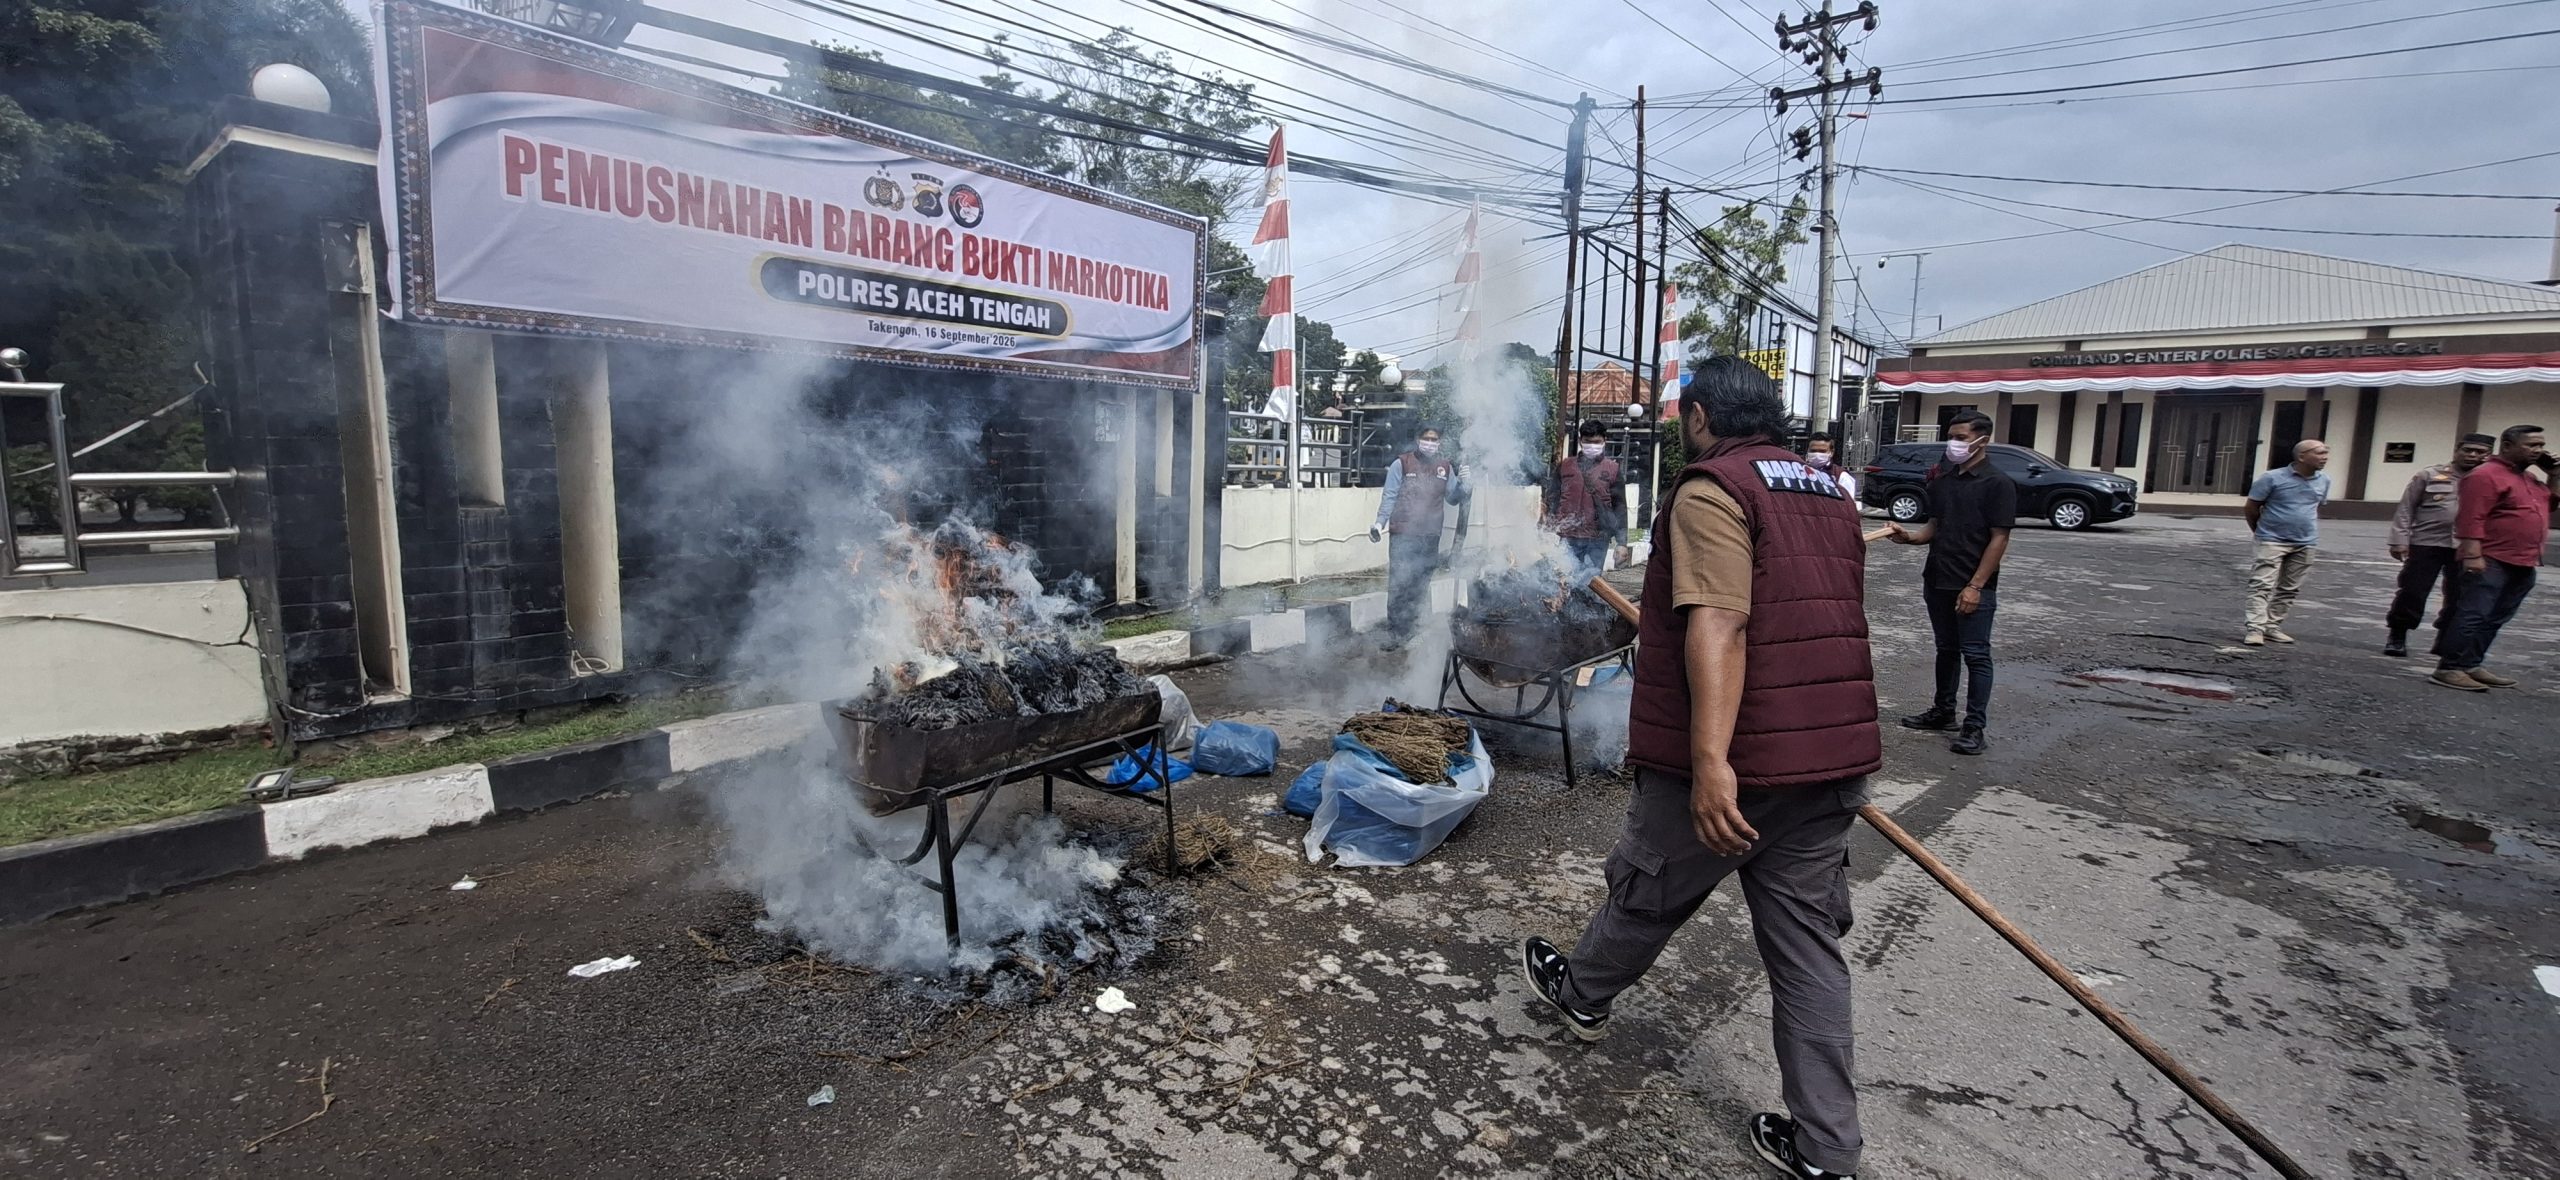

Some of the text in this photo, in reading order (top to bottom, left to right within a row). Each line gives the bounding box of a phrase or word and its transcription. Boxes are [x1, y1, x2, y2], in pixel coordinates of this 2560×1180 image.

[503, 134, 813, 249] PEMUSNAHAN
[823, 203, 954, 273] BARANG
[962, 232, 1041, 288] BUKTI
[1048, 250, 1170, 312] NARKOTIKA
[798, 271, 1050, 330] POLRES ACEH TENGAH
[868, 319, 1015, 348] Takengon, 16 September 2026
[2030, 340, 2443, 367] COMMAND CENTER POLRES ACEH TENGAH
[1765, 477, 1842, 497] POLICE
